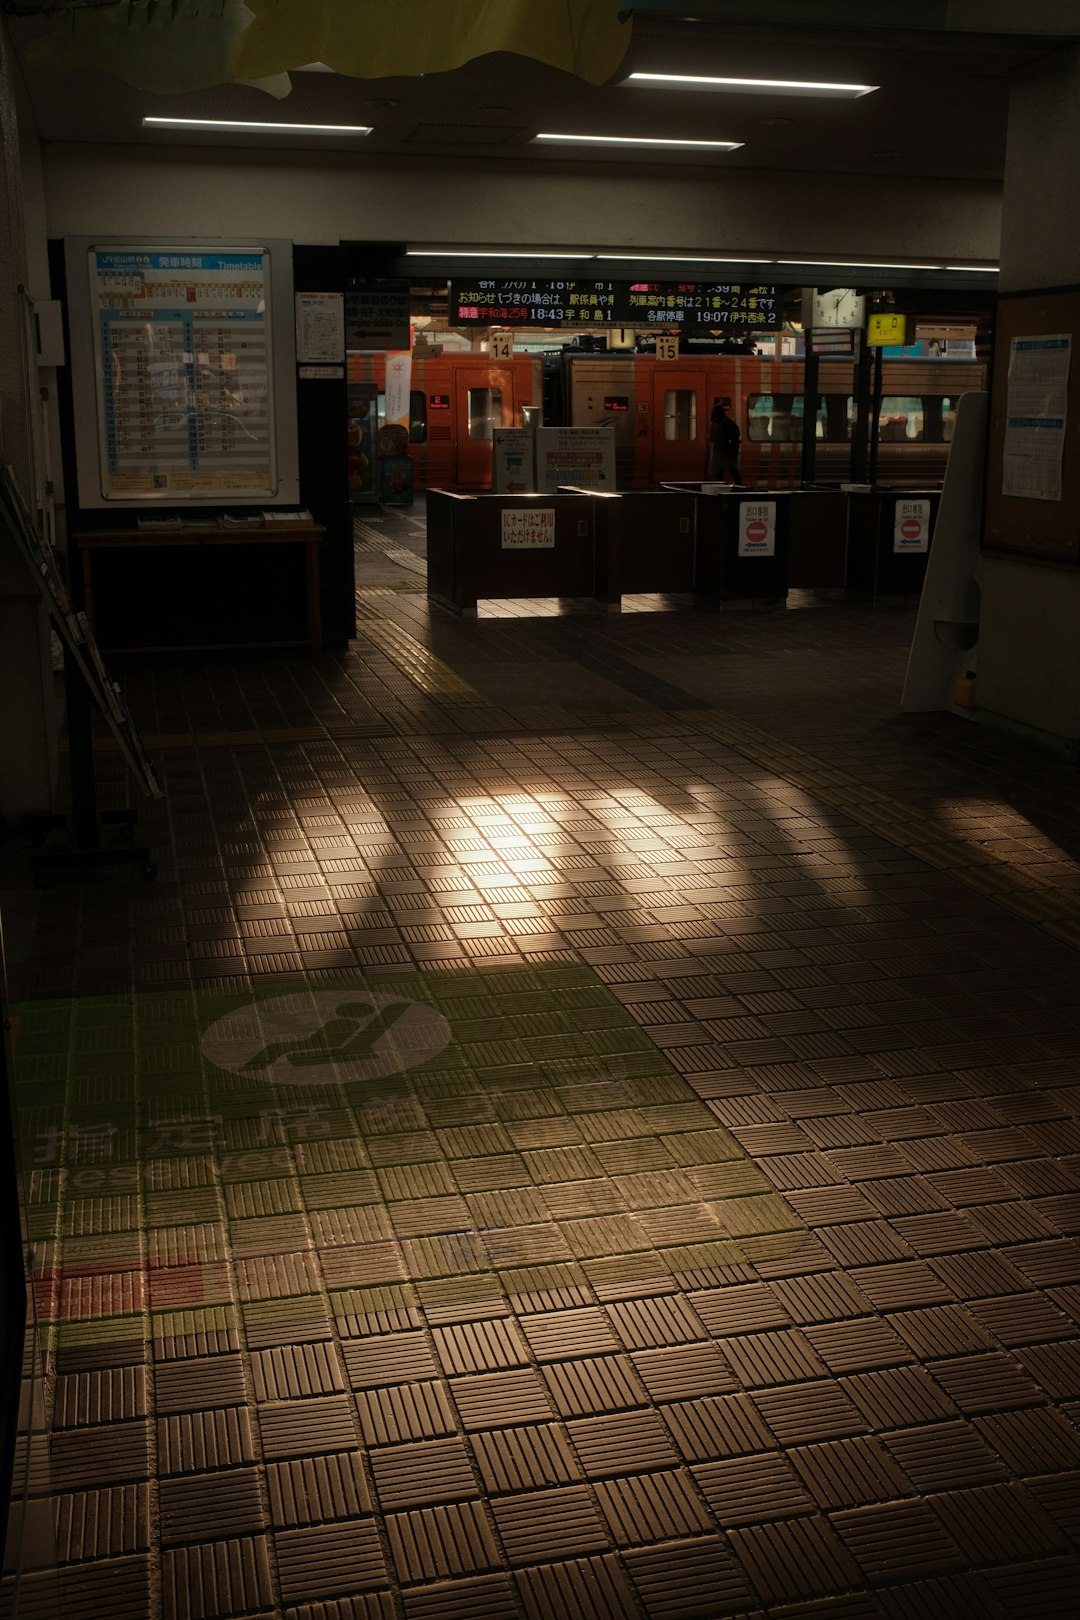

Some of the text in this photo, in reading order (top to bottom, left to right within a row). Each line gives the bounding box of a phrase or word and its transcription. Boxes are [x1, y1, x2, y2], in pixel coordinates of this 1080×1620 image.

[159, 256, 202, 268] 発車時刻
[217, 261, 262, 270] Timetable
[458, 291, 496, 304] お知らせ
[530, 308, 563, 320] 18:43
[606, 309, 612, 320] 1
[647, 310, 776, 324] 各駅停車 19:07 伊予西条 2
[492, 343, 510, 358] 14
[659, 345, 675, 359] 15
[503, 512, 554, 528] ICカードはご利用
